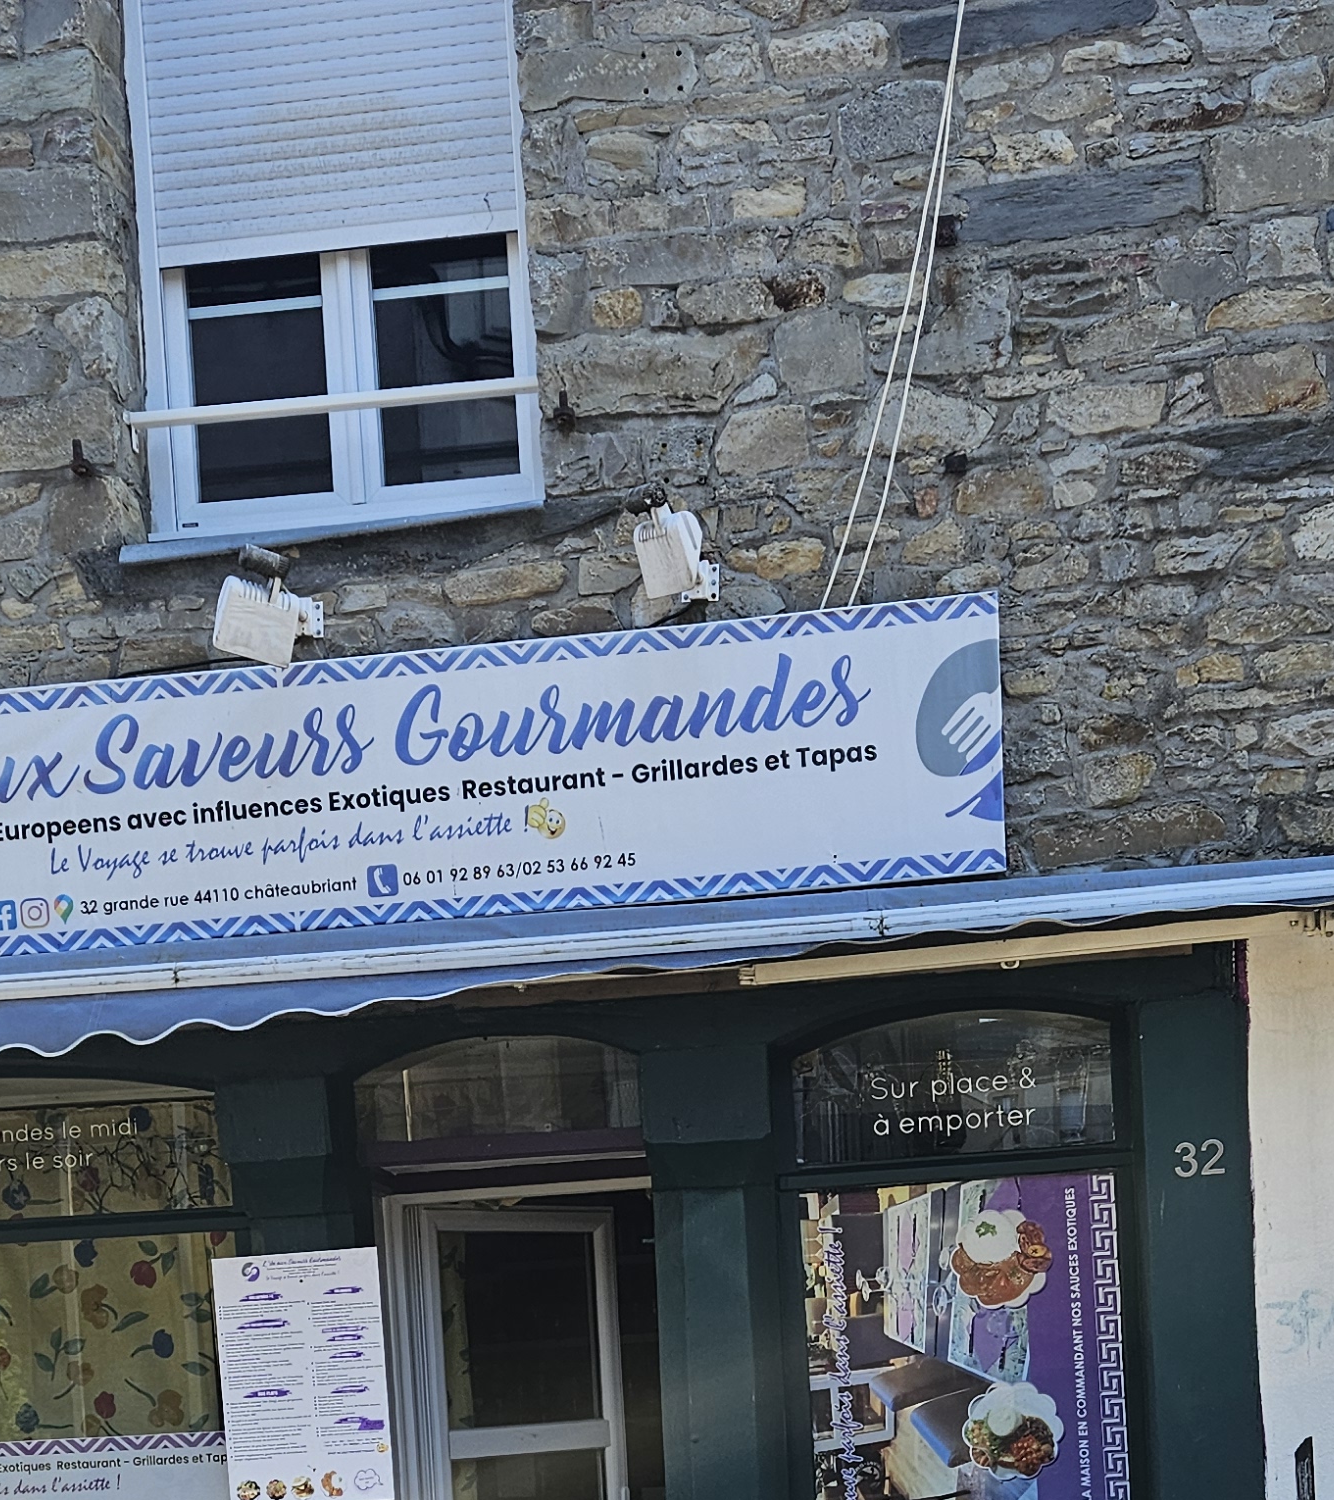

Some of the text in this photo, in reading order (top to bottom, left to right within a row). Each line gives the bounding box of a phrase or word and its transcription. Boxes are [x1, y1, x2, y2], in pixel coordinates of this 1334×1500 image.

[82, 703, 374, 795] Saveurs
[394, 652, 871, 768] Gourmandes
[126, 808, 187, 831] avec
[192, 793, 322, 825] influences
[328, 782, 450, 813] Exotiques
[462, 767, 605, 800] Restaurant
[631, 755, 758, 785] Grillardes
[765, 751, 791, 773] et
[796, 741, 878, 769] Tapas
[51, 846, 71, 875] Le
[77, 844, 150, 881] Voyage
[158, 852, 179, 868] se
[185, 838, 254, 864] trouve
[260, 825, 339, 868] parfois
[347, 816, 405, 850] dans
[412, 812, 513, 843] l'assiette
[80, 852, 637, 915] 32 grande rue 44110 châteaubriant 06 01 92 89 63/02 53 66 92 45
[870, 1066, 1037, 1105] Sur place &
[62, 1121, 82, 1138] le
[90, 1117, 138, 1138] midi
[873, 1104, 1036, 1138] à emporter
[26, 1151, 44, 1170] le
[52, 1149, 94, 1169] soir
[1173, 1138, 1226, 1178] 32
[1064, 1187, 1078, 1251] EXOTIQUES
[1068, 1253, 1081, 1298] SAUCES
[1071, 1300, 1083, 1327] NOS
[828, 1334, 852, 1387] dans
[1073, 1329, 1088, 1418] COMMANDANT
[830, 1390, 864, 1463] parfois
[1077, 1420, 1089, 1437] EN
[56, 1457, 121, 1472] Restaurant
[133, 1454, 189, 1466] Grillardes
[192, 1454, 204, 1464] et
[206, 1453, 227, 1465] Tap
[1079, 1440, 1092, 1490] MAISON
[11, 1476, 48, 1495] dans
